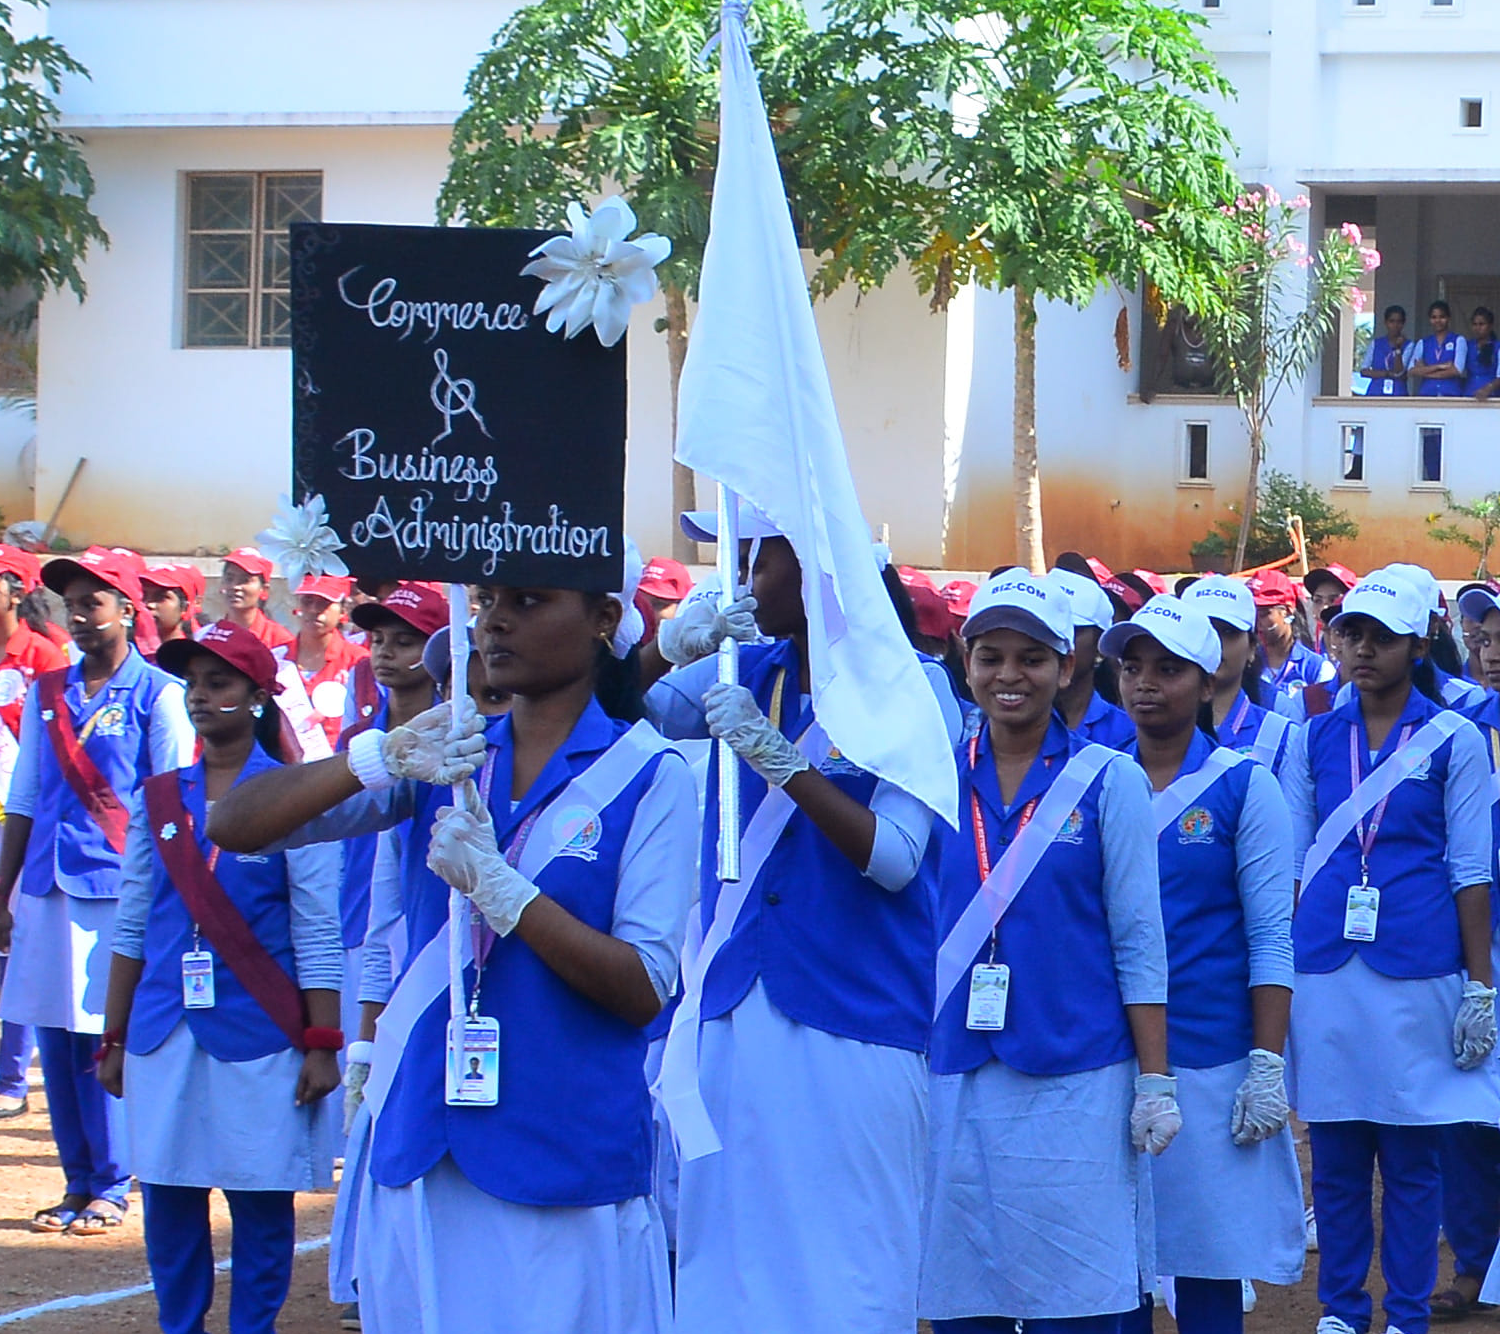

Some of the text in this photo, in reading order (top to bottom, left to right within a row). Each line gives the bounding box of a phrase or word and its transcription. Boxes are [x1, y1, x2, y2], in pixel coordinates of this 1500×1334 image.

[338, 266, 528, 343] Commerce
[333, 428, 498, 502] Business
[351, 489, 612, 575] Administration
[991, 581, 1047, 601] BIZ-COM
